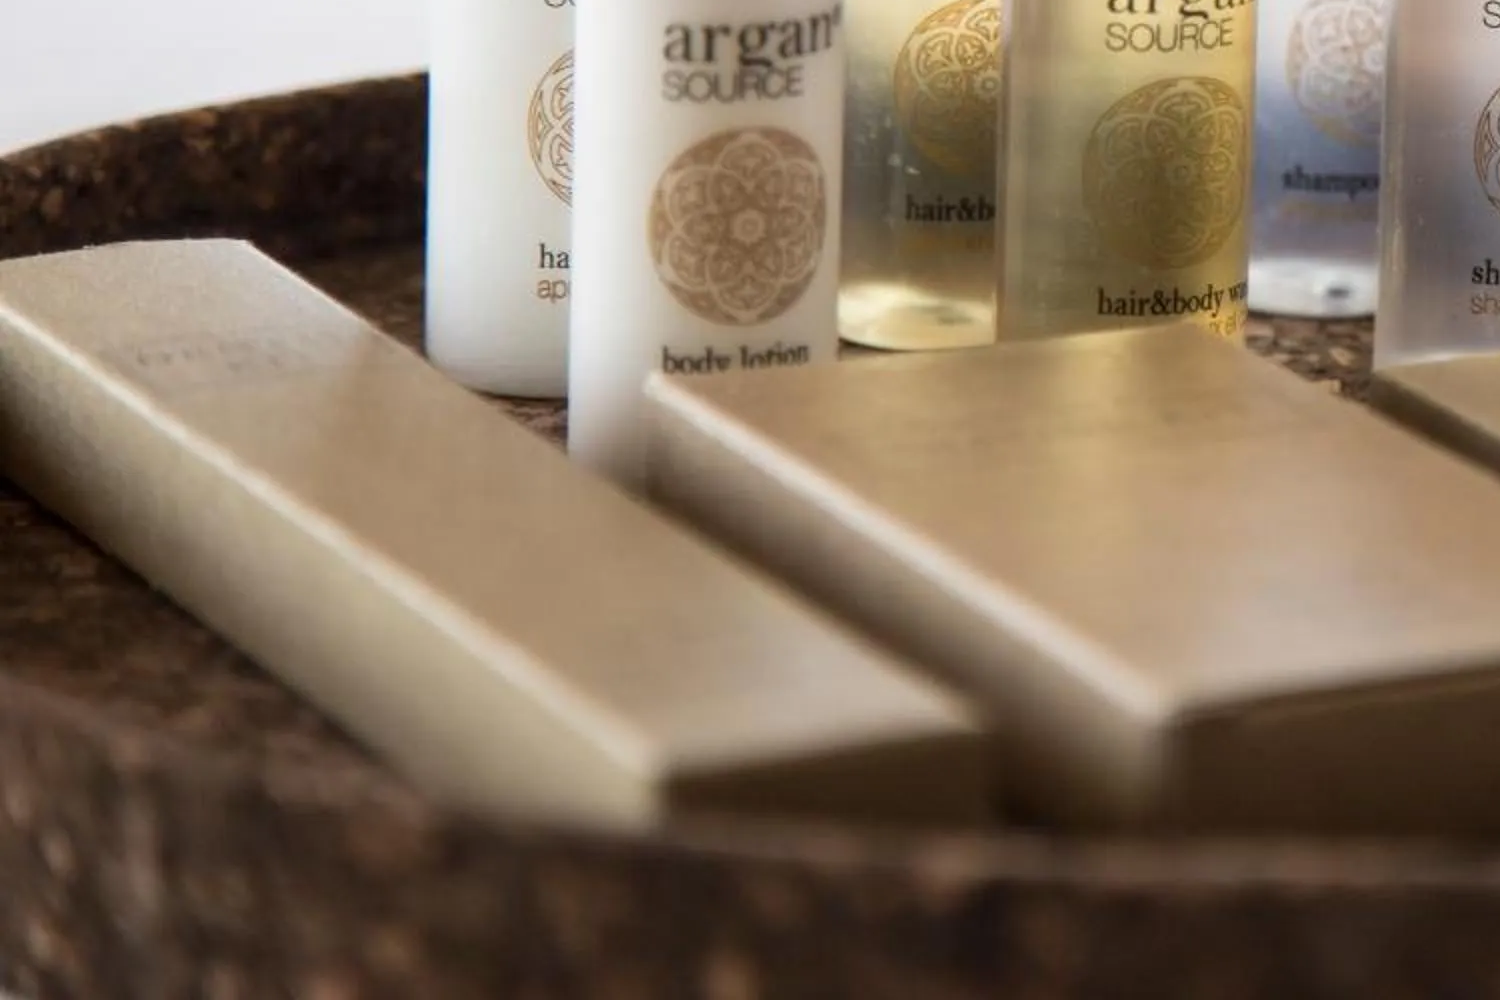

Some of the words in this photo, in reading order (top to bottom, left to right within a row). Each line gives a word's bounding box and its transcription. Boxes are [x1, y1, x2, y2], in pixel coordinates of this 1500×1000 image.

[1105, 17, 1234, 53] SOURCE
[661, 64, 804, 104] SOURCE
[1282, 163, 1380, 200] shampo
[905, 193, 996, 222] hair&b
[1097, 283, 1224, 318] hair&body
[662, 345, 732, 374] body
[738, 340, 809, 371] lotion
